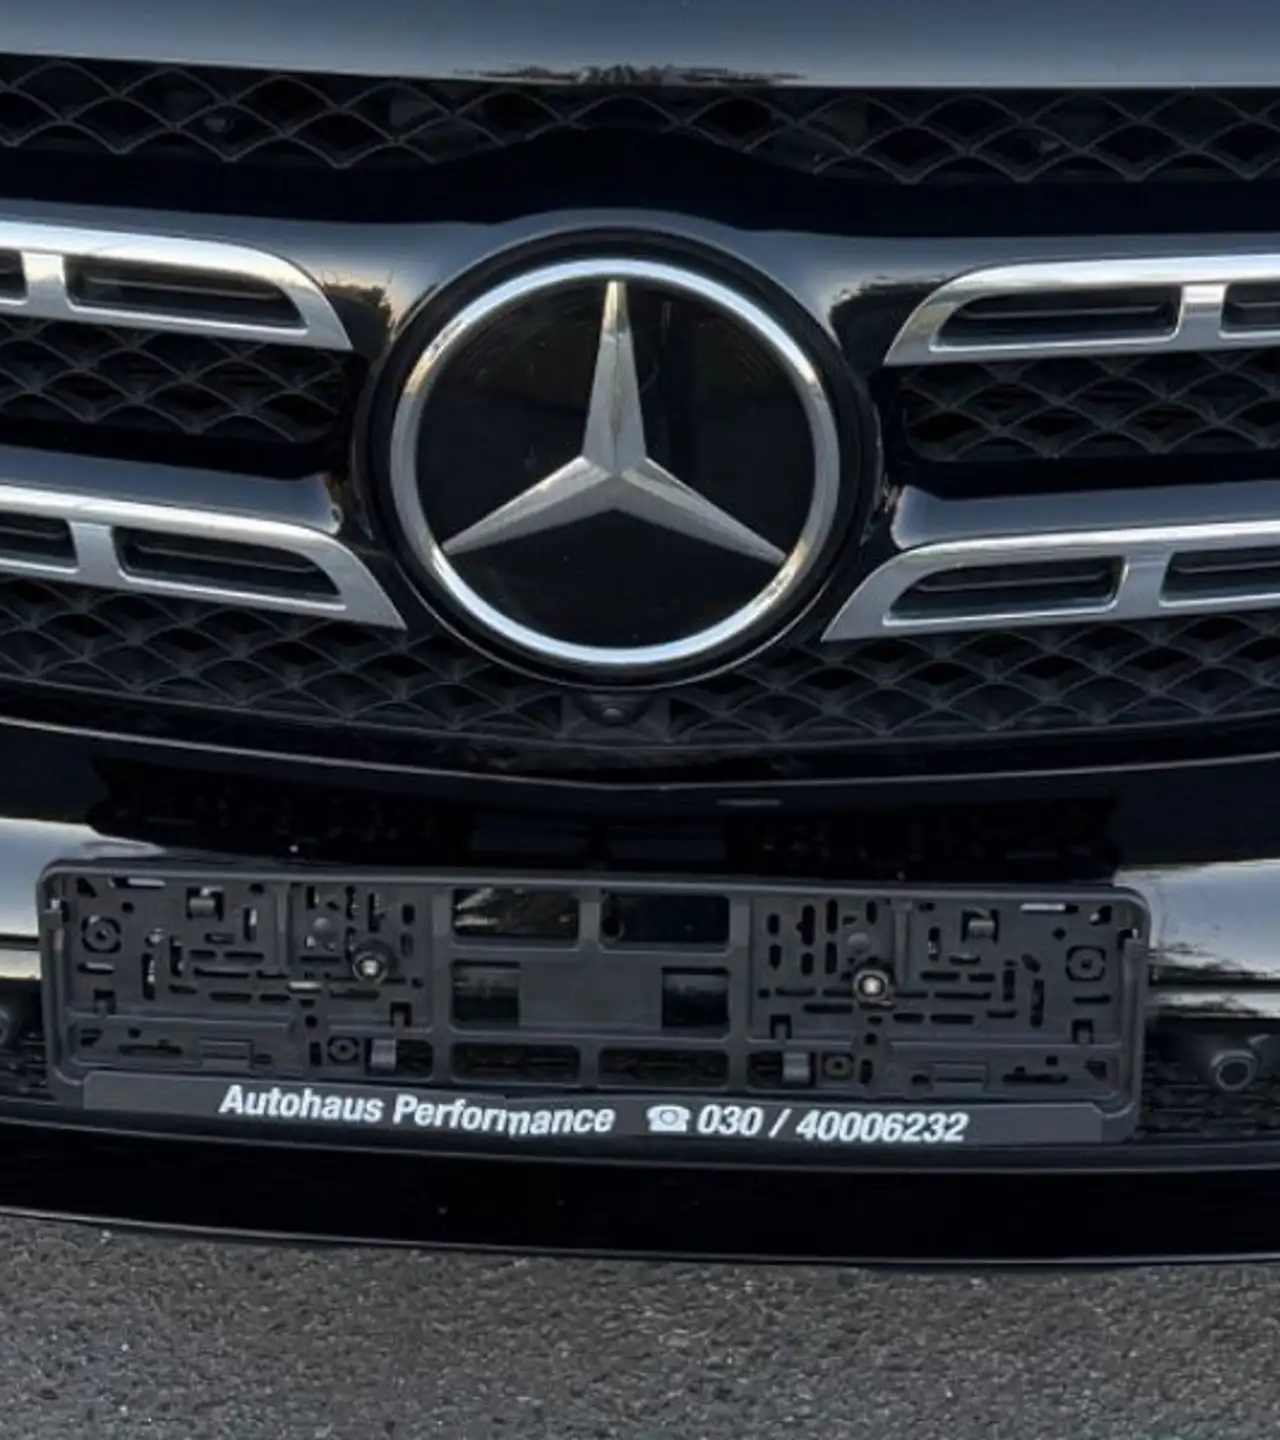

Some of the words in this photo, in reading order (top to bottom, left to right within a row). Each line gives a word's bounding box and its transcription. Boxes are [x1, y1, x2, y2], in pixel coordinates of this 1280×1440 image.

[218, 1083, 385, 1123] Autohaus
[392, 1093, 616, 1137] Performance
[696, 1103, 765, 1137] 030
[767, 1107, 793, 1139] /
[795, 1109, 970, 1144] 40006232
